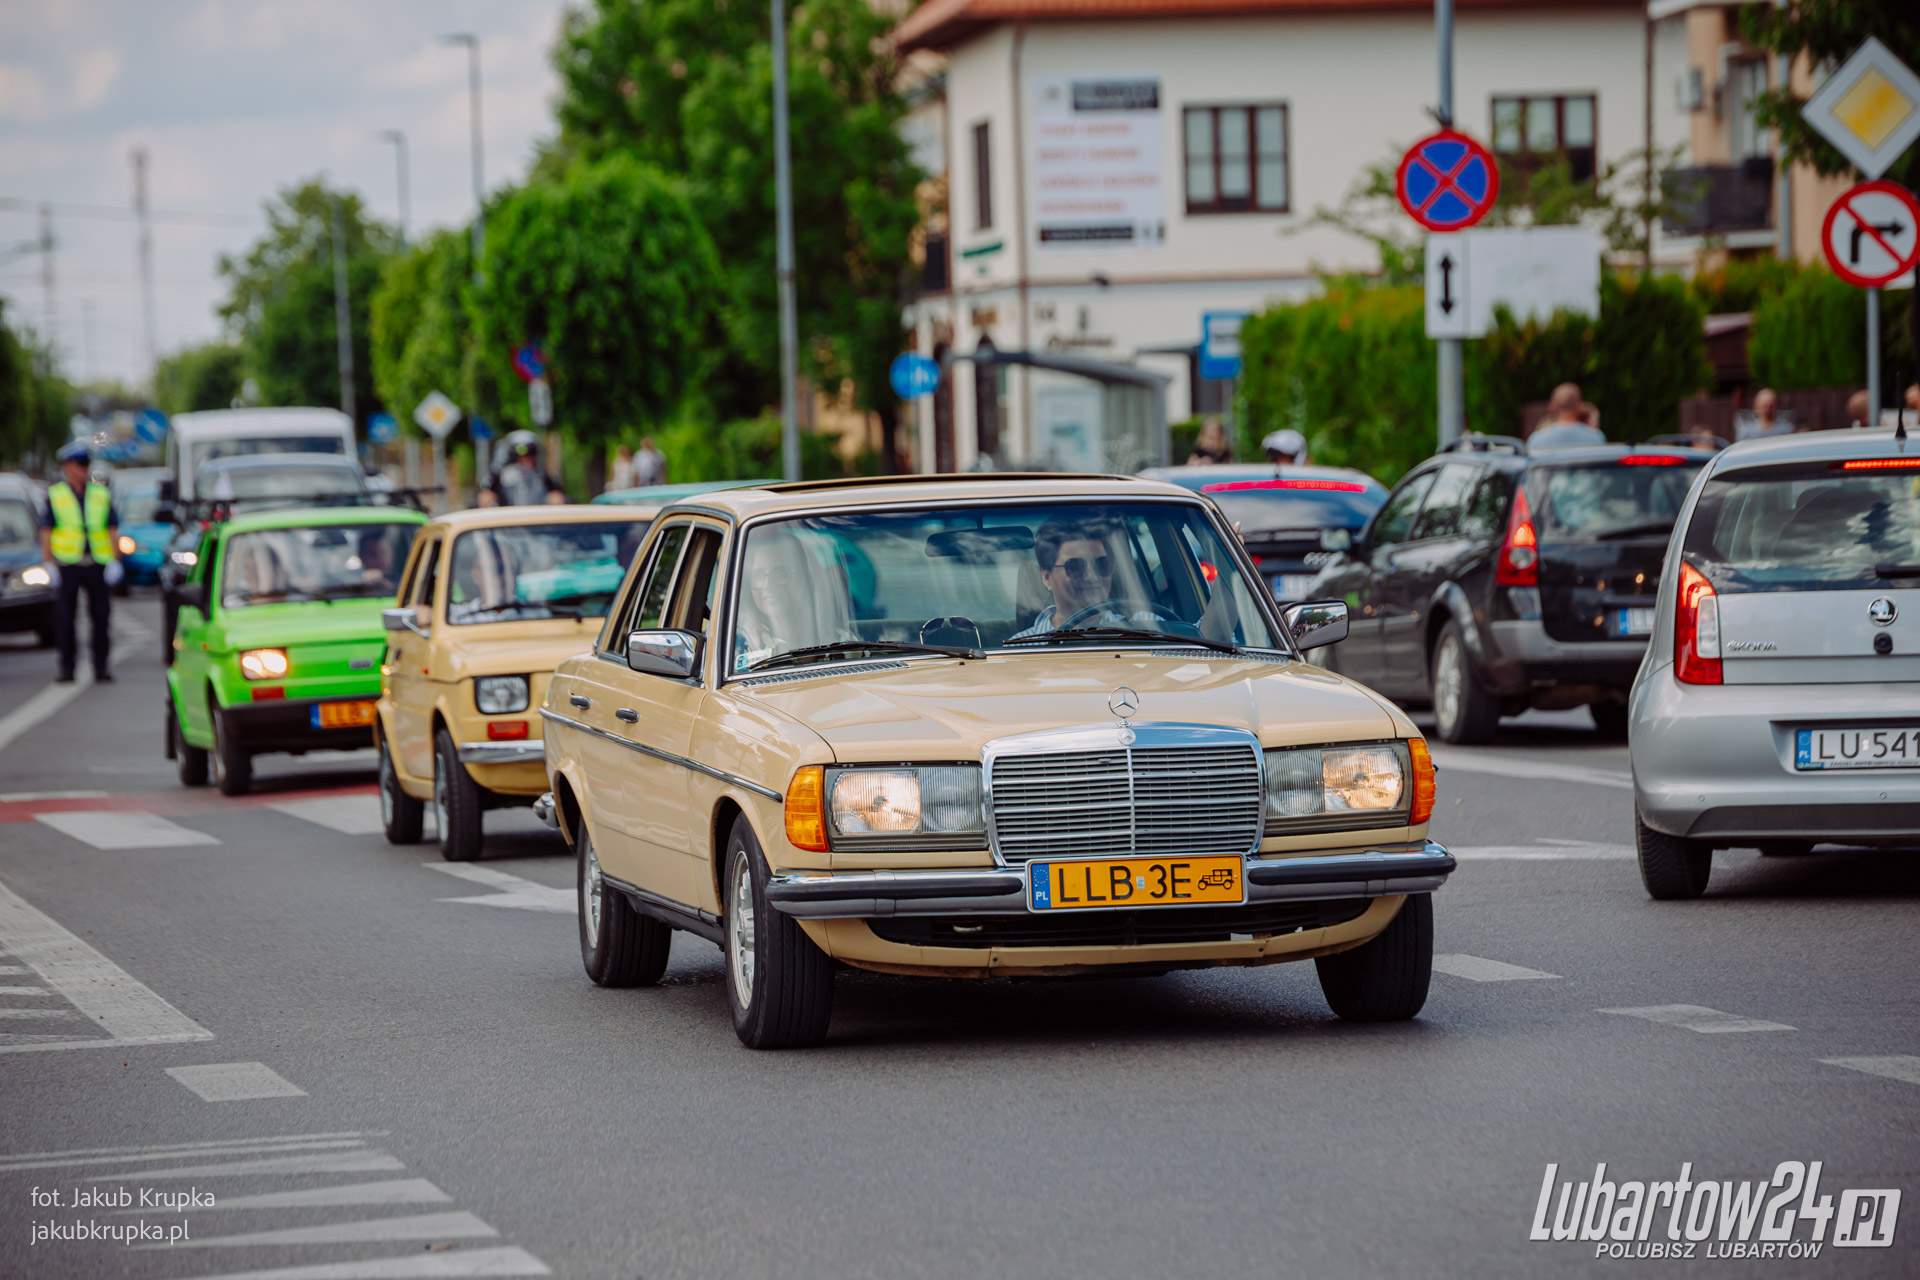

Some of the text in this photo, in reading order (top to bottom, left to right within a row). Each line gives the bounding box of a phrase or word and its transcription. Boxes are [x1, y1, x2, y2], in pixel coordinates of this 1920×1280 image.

[1819, 733, 1861, 759] LU
[1058, 863, 1192, 902] LLB 3E
[1035, 891, 1048, 901] PL
